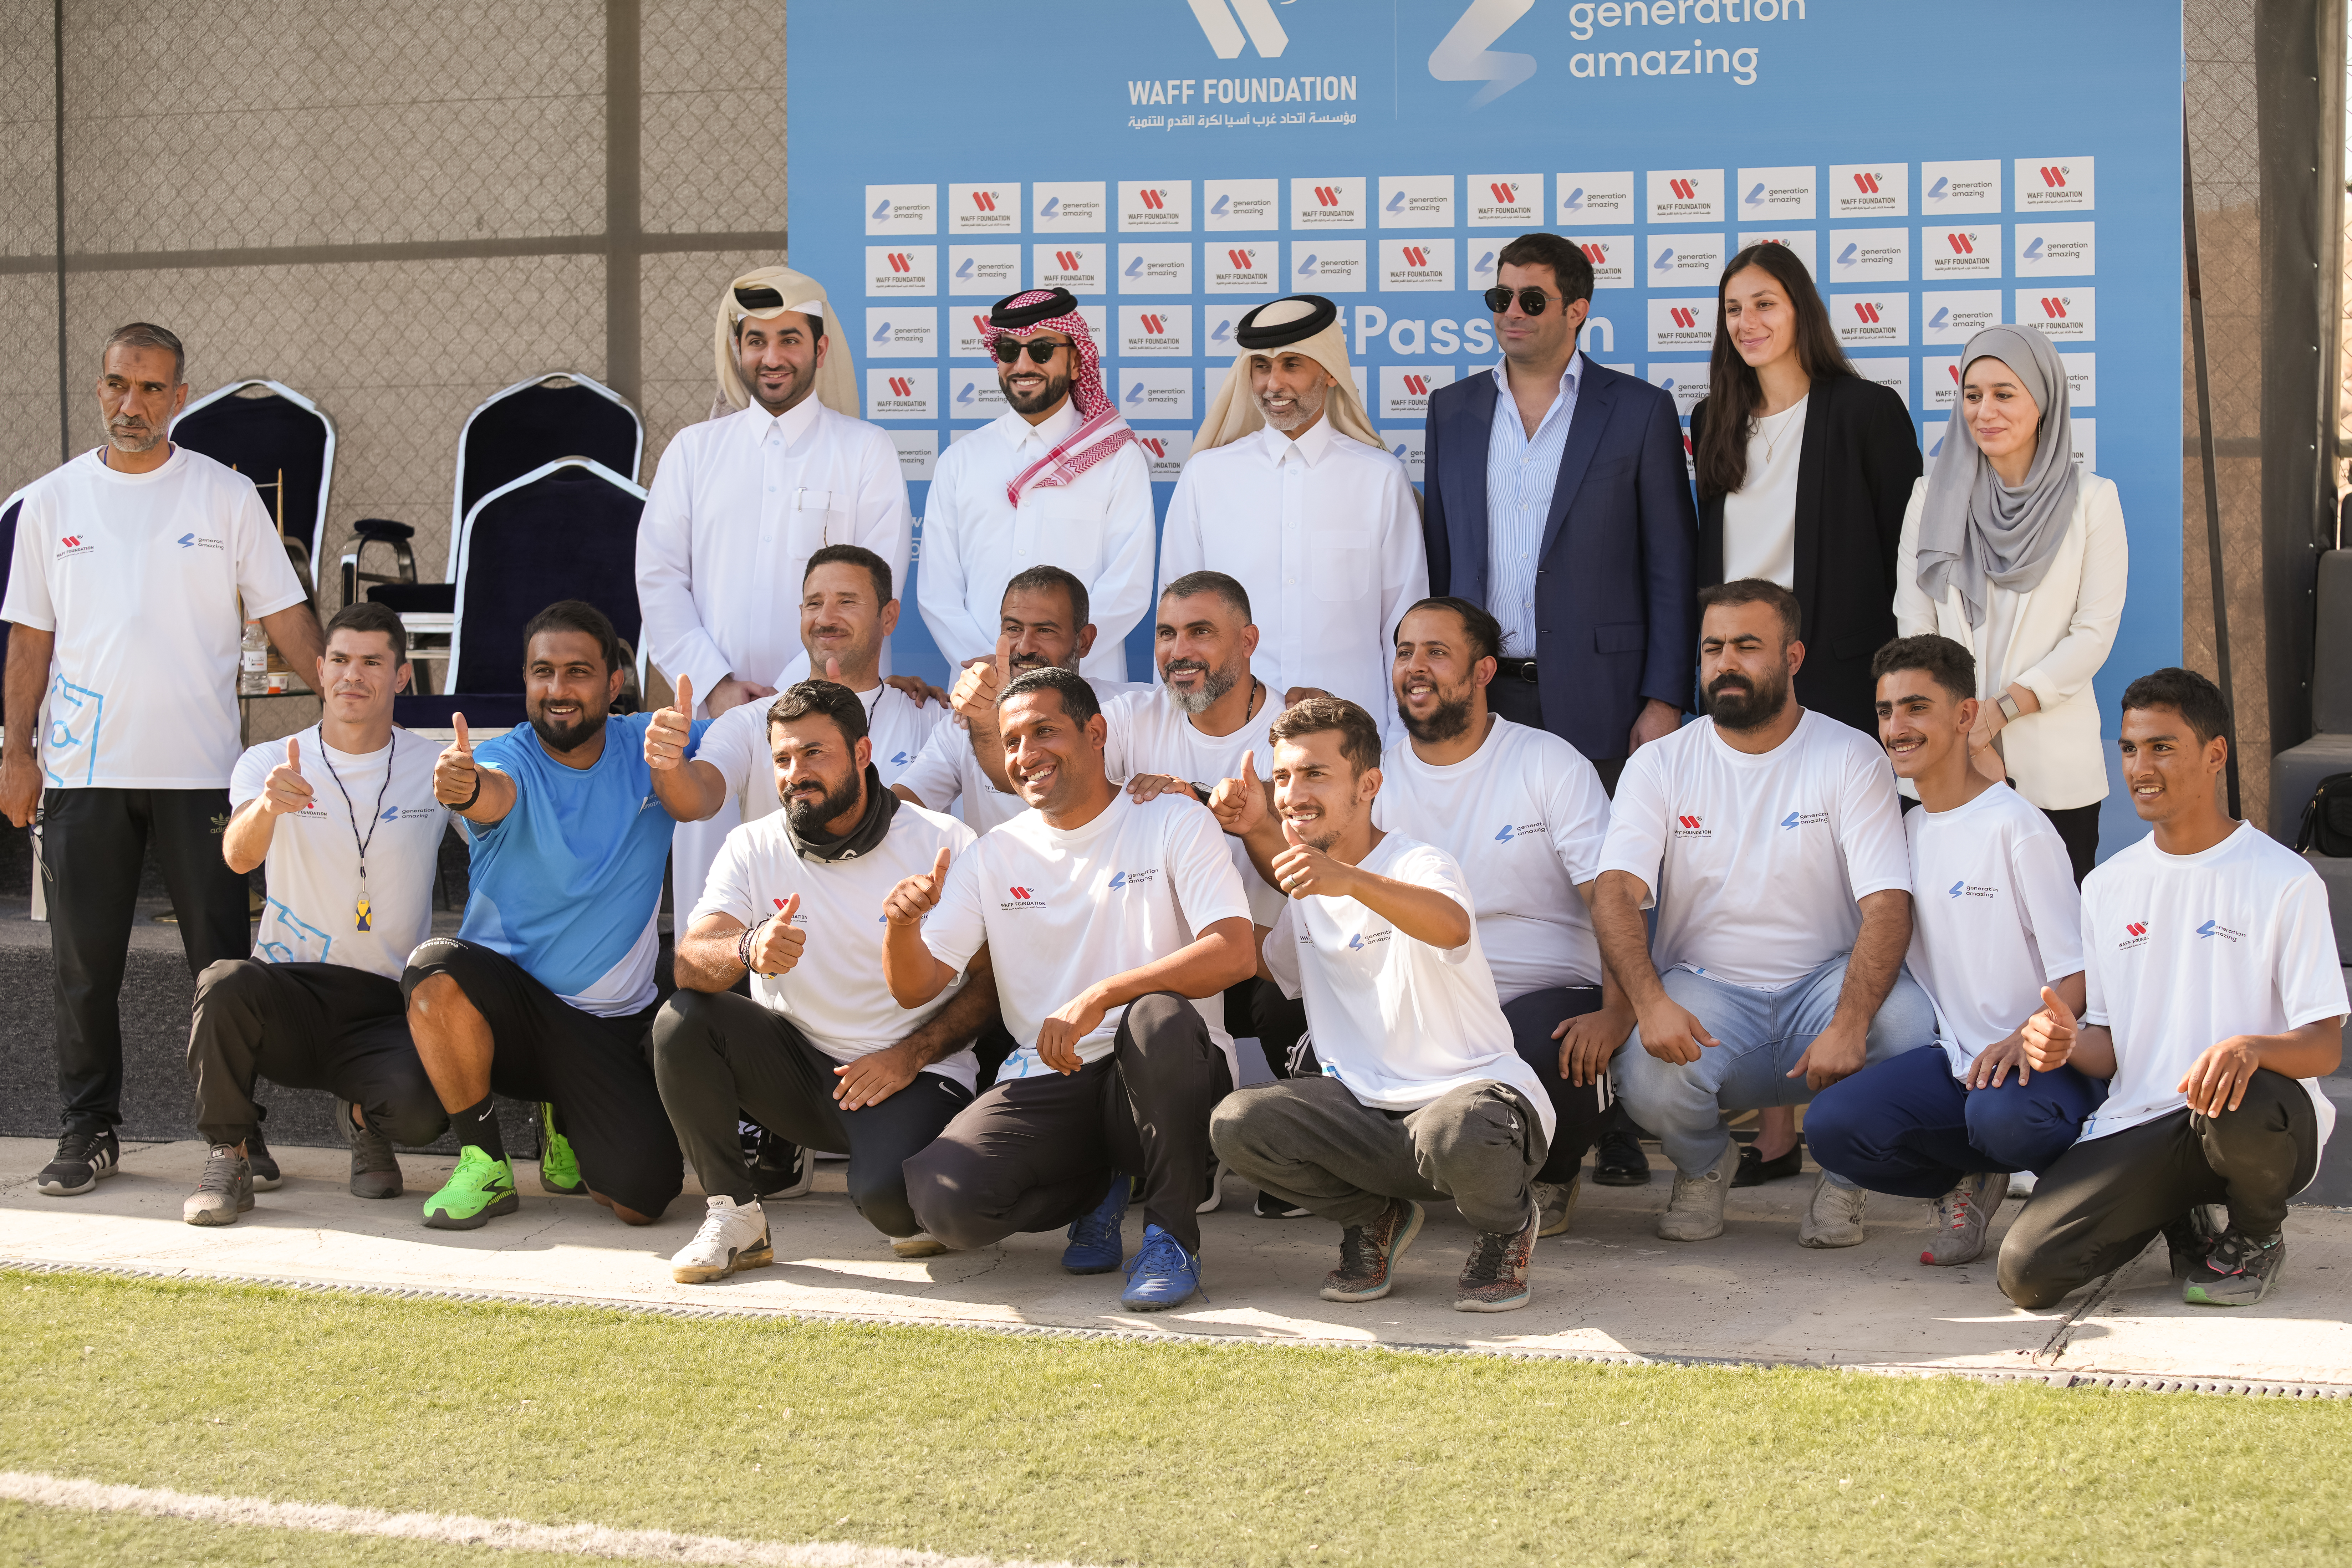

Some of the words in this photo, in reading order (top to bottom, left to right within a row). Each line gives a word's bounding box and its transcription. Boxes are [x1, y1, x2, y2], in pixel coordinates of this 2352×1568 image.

[1569, 0, 1806, 41] generation
[1569, 39, 1759, 86] amazing
[1128, 80, 1195, 105] WAFF
[1204, 76, 1357, 103] FOUNDATION
[1128, 116, 1164, 129] للتنمية
[1198, 114, 1222, 128] لكرة
[1252, 113, 1277, 127] غرب
[1280, 112, 1305, 124] اتحاد
[1309, 111, 1356, 125] مؤسسة
[1167, 115, 1195, 132] القدم
[1952, 181, 1992, 190] generation
[1769, 187, 1808, 196] generation
[1952, 190, 1984, 198] amazing
[1409, 196, 1447, 205] generation
[1587, 193, 1626, 201] generation
[1769, 196, 1801, 204] amazing
[1063, 202, 1100, 210] generation
[1233, 199, 1271, 208] generation
[1587, 201, 1618, 209] amazing
[2047, 242, 2088, 251] generation
[1861, 247, 1901, 257] generation
[2047, 250, 2080, 259] amazing
[1678, 253, 1717, 262] generation
[1861, 256, 1893, 264] amazing
[1147, 261, 1184, 270] generation
[1321, 259, 1358, 268] generation
[1321, 267, 1351, 276] amazing
[1953, 312, 1993, 320] generation
[1953, 320, 1985, 328] amazing
[894, 327, 930, 335] generation
[1678, 383, 1710, 392] generati
[1148, 396, 1178, 404] amazing
[66, 546, 94, 554] FOUNDATION
[2215, 925, 2246, 937] eneration
[2215, 931, 2237, 942] mazing
[420, 940, 459, 950] amazing
